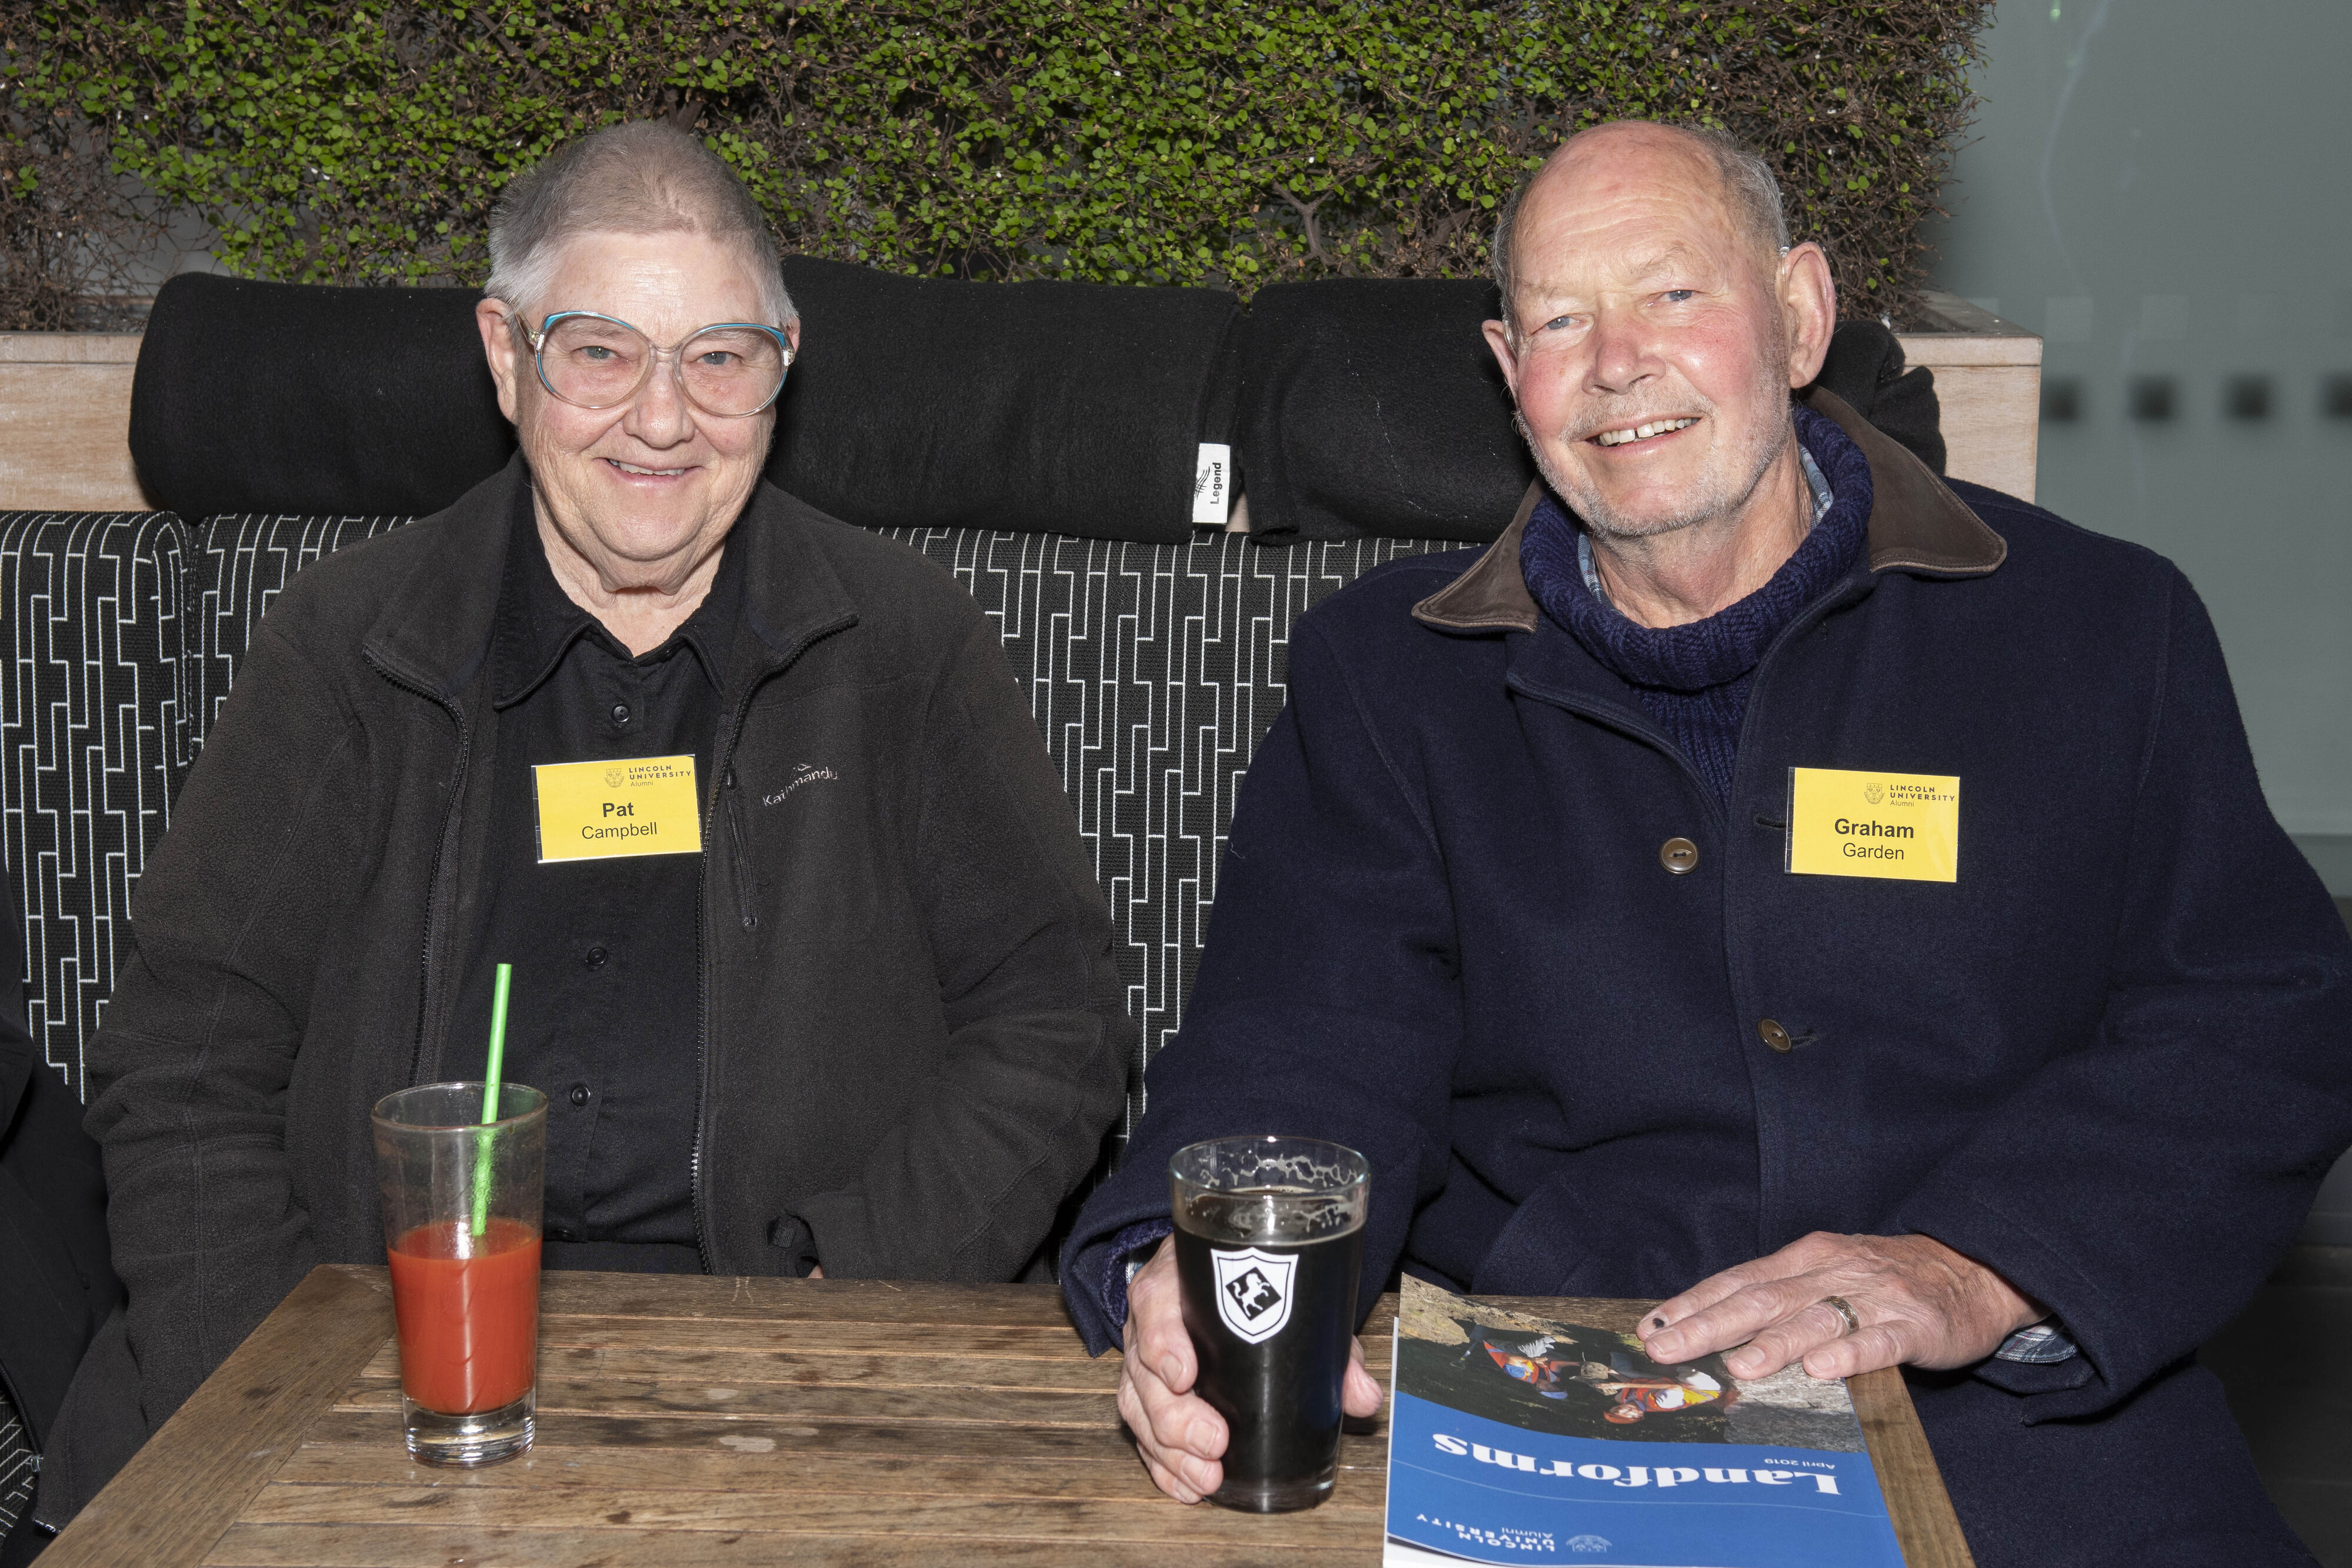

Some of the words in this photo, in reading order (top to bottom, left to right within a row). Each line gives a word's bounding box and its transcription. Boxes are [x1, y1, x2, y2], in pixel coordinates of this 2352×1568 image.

[1210, 462, 1223, 504] Legend
[629, 765, 672, 773] LINCOLN
[629, 770, 692, 780] UNIVERSITY
[1890, 784, 1935, 793] LINCOLN
[1890, 792, 1956, 802] UNIVERSITY
[602, 802, 635, 818] Pat
[582, 822, 658, 840] Campbell
[1834, 818, 1914, 839] Graham
[1843, 842, 1904, 860] Garden
[1432, 1433, 1843, 1495] Landforms
[1802, 1460, 1836, 1470] April
[1416, 1513, 1555, 1546] UNIVERSITY
[1502, 1527, 1553, 1539] Alumni
[1459, 1532, 1555, 1552] LINCOLN
